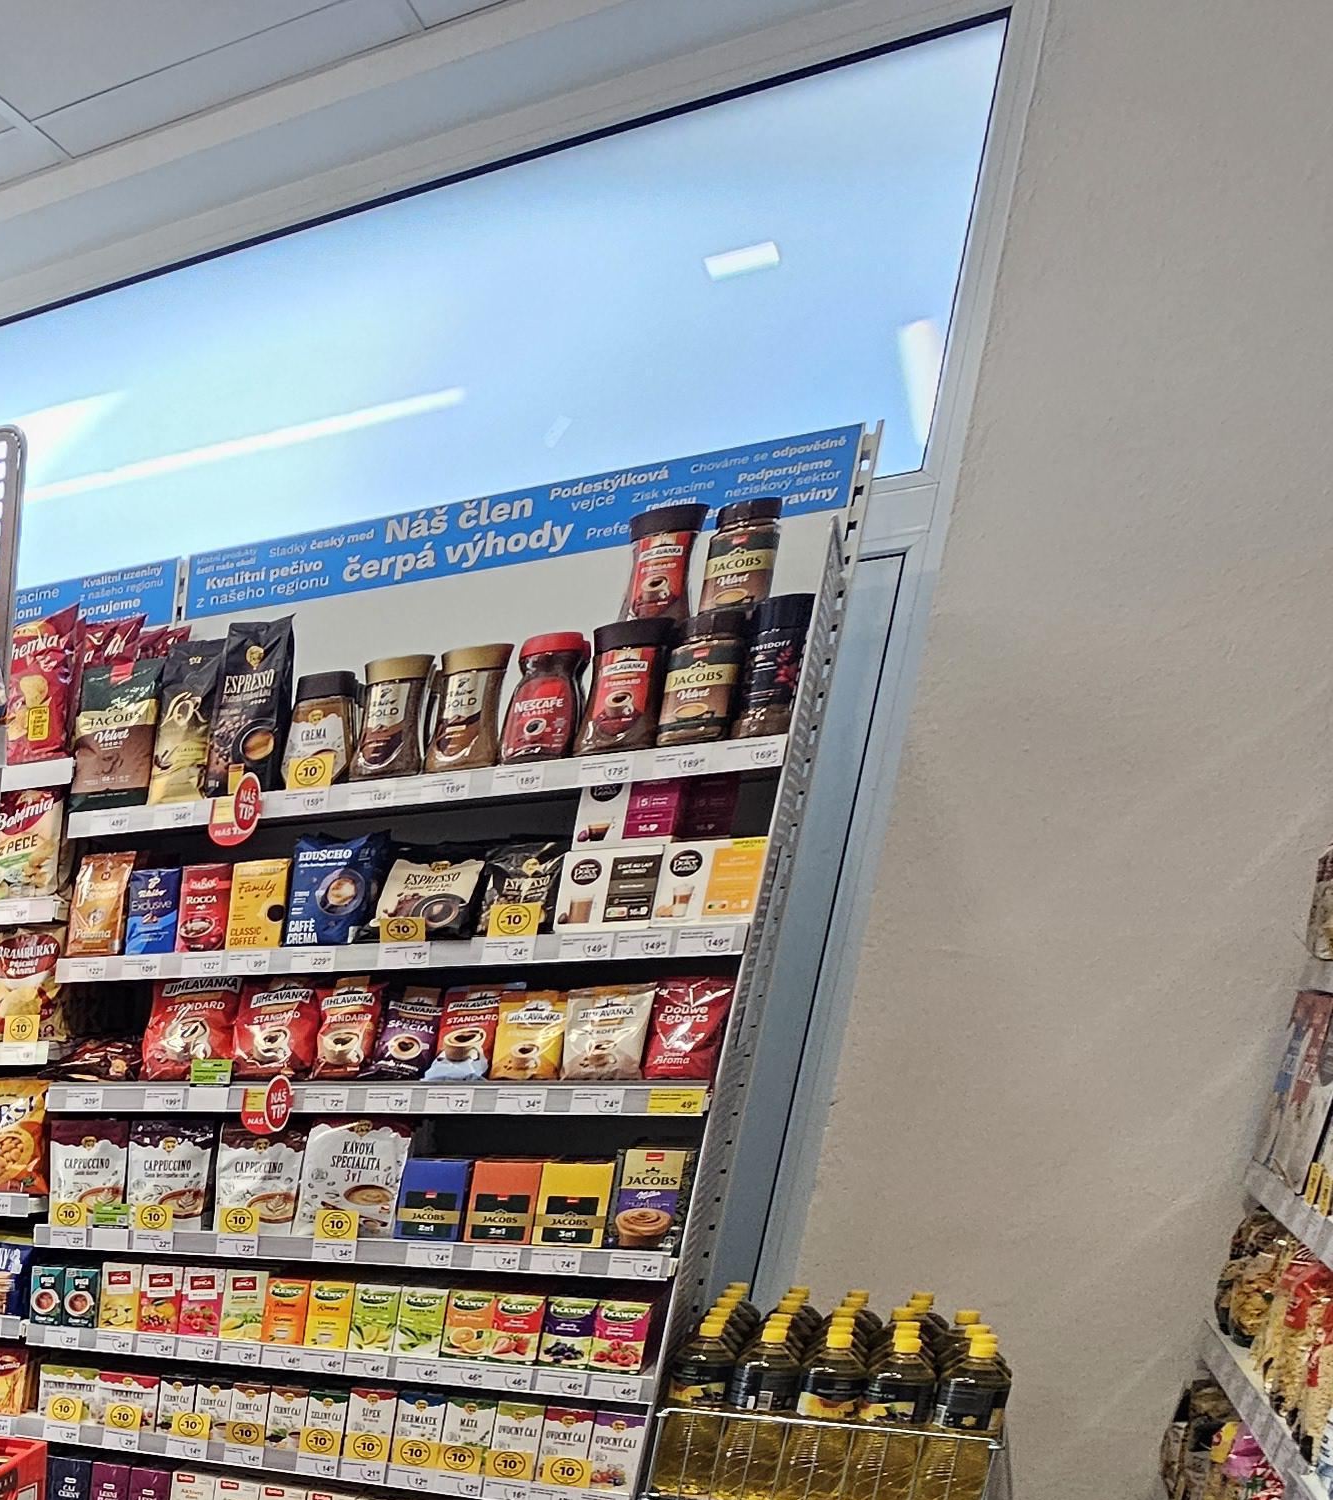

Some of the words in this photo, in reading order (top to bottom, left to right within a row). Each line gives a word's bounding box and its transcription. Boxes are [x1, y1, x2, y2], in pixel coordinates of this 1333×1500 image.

[690, 454, 749, 475] Chováme
[752, 451, 768, 464] se
[772, 434, 848, 460] odpovědné
[737, 457, 833, 484] Podporujeme
[550, 465, 669, 501] Podestýlková
[724, 475, 794, 499] neziskový
[797, 468, 842, 487] sektor
[633, 489, 660, 503] Zisk
[661, 479, 716, 499] vracíme
[571, 493, 616, 513] vejce
[384, 510, 448, 544] Náš
[457, 496, 534, 530] člen
[269, 541, 307, 559] Sladký
[310, 534, 345, 553] český
[347, 528, 374, 544] med
[342, 543, 435, 584] čerpá
[444, 519, 574, 570] výhody
[712, 555, 762, 574] JACOBS
[82, 572, 122, 588] Kvalitní
[123, 565, 163, 580] uzeniny
[205, 566, 266, 591] Kvalitní
[268, 559, 323, 582] pečivo
[716, 573, 749, 587] Velvet
[87, 586, 124, 600] našeho
[126, 577, 164, 594] regionu
[196, 597, 205, 609] z
[209, 586, 265, 607] našeho
[271, 575, 329, 598] regionu
[16, 587, 60, 605] racíme
[223, 671, 275, 694] ESPRESSO
[673, 669, 723, 686] JACOBS
[677, 687, 710, 701] Velvet
[89, 711, 142, 728] JACOBS
[94, 728, 130, 743] Velvet
[301, 727, 327, 740] CREMA
[240, 788, 257, 802] NÁŠ
[239, 803, 254, 819] TIP
[7, 834, 39, 853] PECE
[298, 849, 353, 862] EDUSCHO
[673, 857, 700, 869] Dolce
[404, 871, 461, 884] ESPRESSO
[574, 865, 600, 877] Dolce
[238, 880, 277, 896] Family
[131, 899, 173, 912] Exclusive
[186, 895, 217, 905] ROCCA
[75, 928, 112, 940] Paloma
[229, 926, 263, 938] CLASSIC
[286, 931, 318, 945] CREMA
[229, 936, 258, 945] COFFEE
[165, 976, 238, 994] JIHLAVANKA
[252, 989, 311, 1006] JIHLAVANKA
[166, 1001, 225, 1013] STANDARD
[664, 1004, 709, 1015] Douwe
[446, 1014, 498, 1024] STANDARD
[658, 1013, 709, 1026] Egberts
[387, 1020, 435, 1034] SPECIAL
[653, 1056, 690, 1065] Aroma
[270, 1104, 286, 1119] TIP
[343, 1140, 375, 1156] KÁVOVÁ
[64, 1158, 110, 1170] CAPPUCCINO
[143, 1160, 191, 1172] CAPPUCCINO
[234, 1161, 283, 1174] CAPPUCCINO
[625, 1174, 678, 1187] JACOBS
[411, 1213, 446, 1221] JACOBS
[482, 1215, 518, 1225] JACOBS
[551, 1218, 589, 1227] JACOBS
[499, 1303, 540, 1315] PICKWICK
[550, 1305, 592, 1317] PICKWICK
[602, 1309, 644, 1322] PICKWICK
